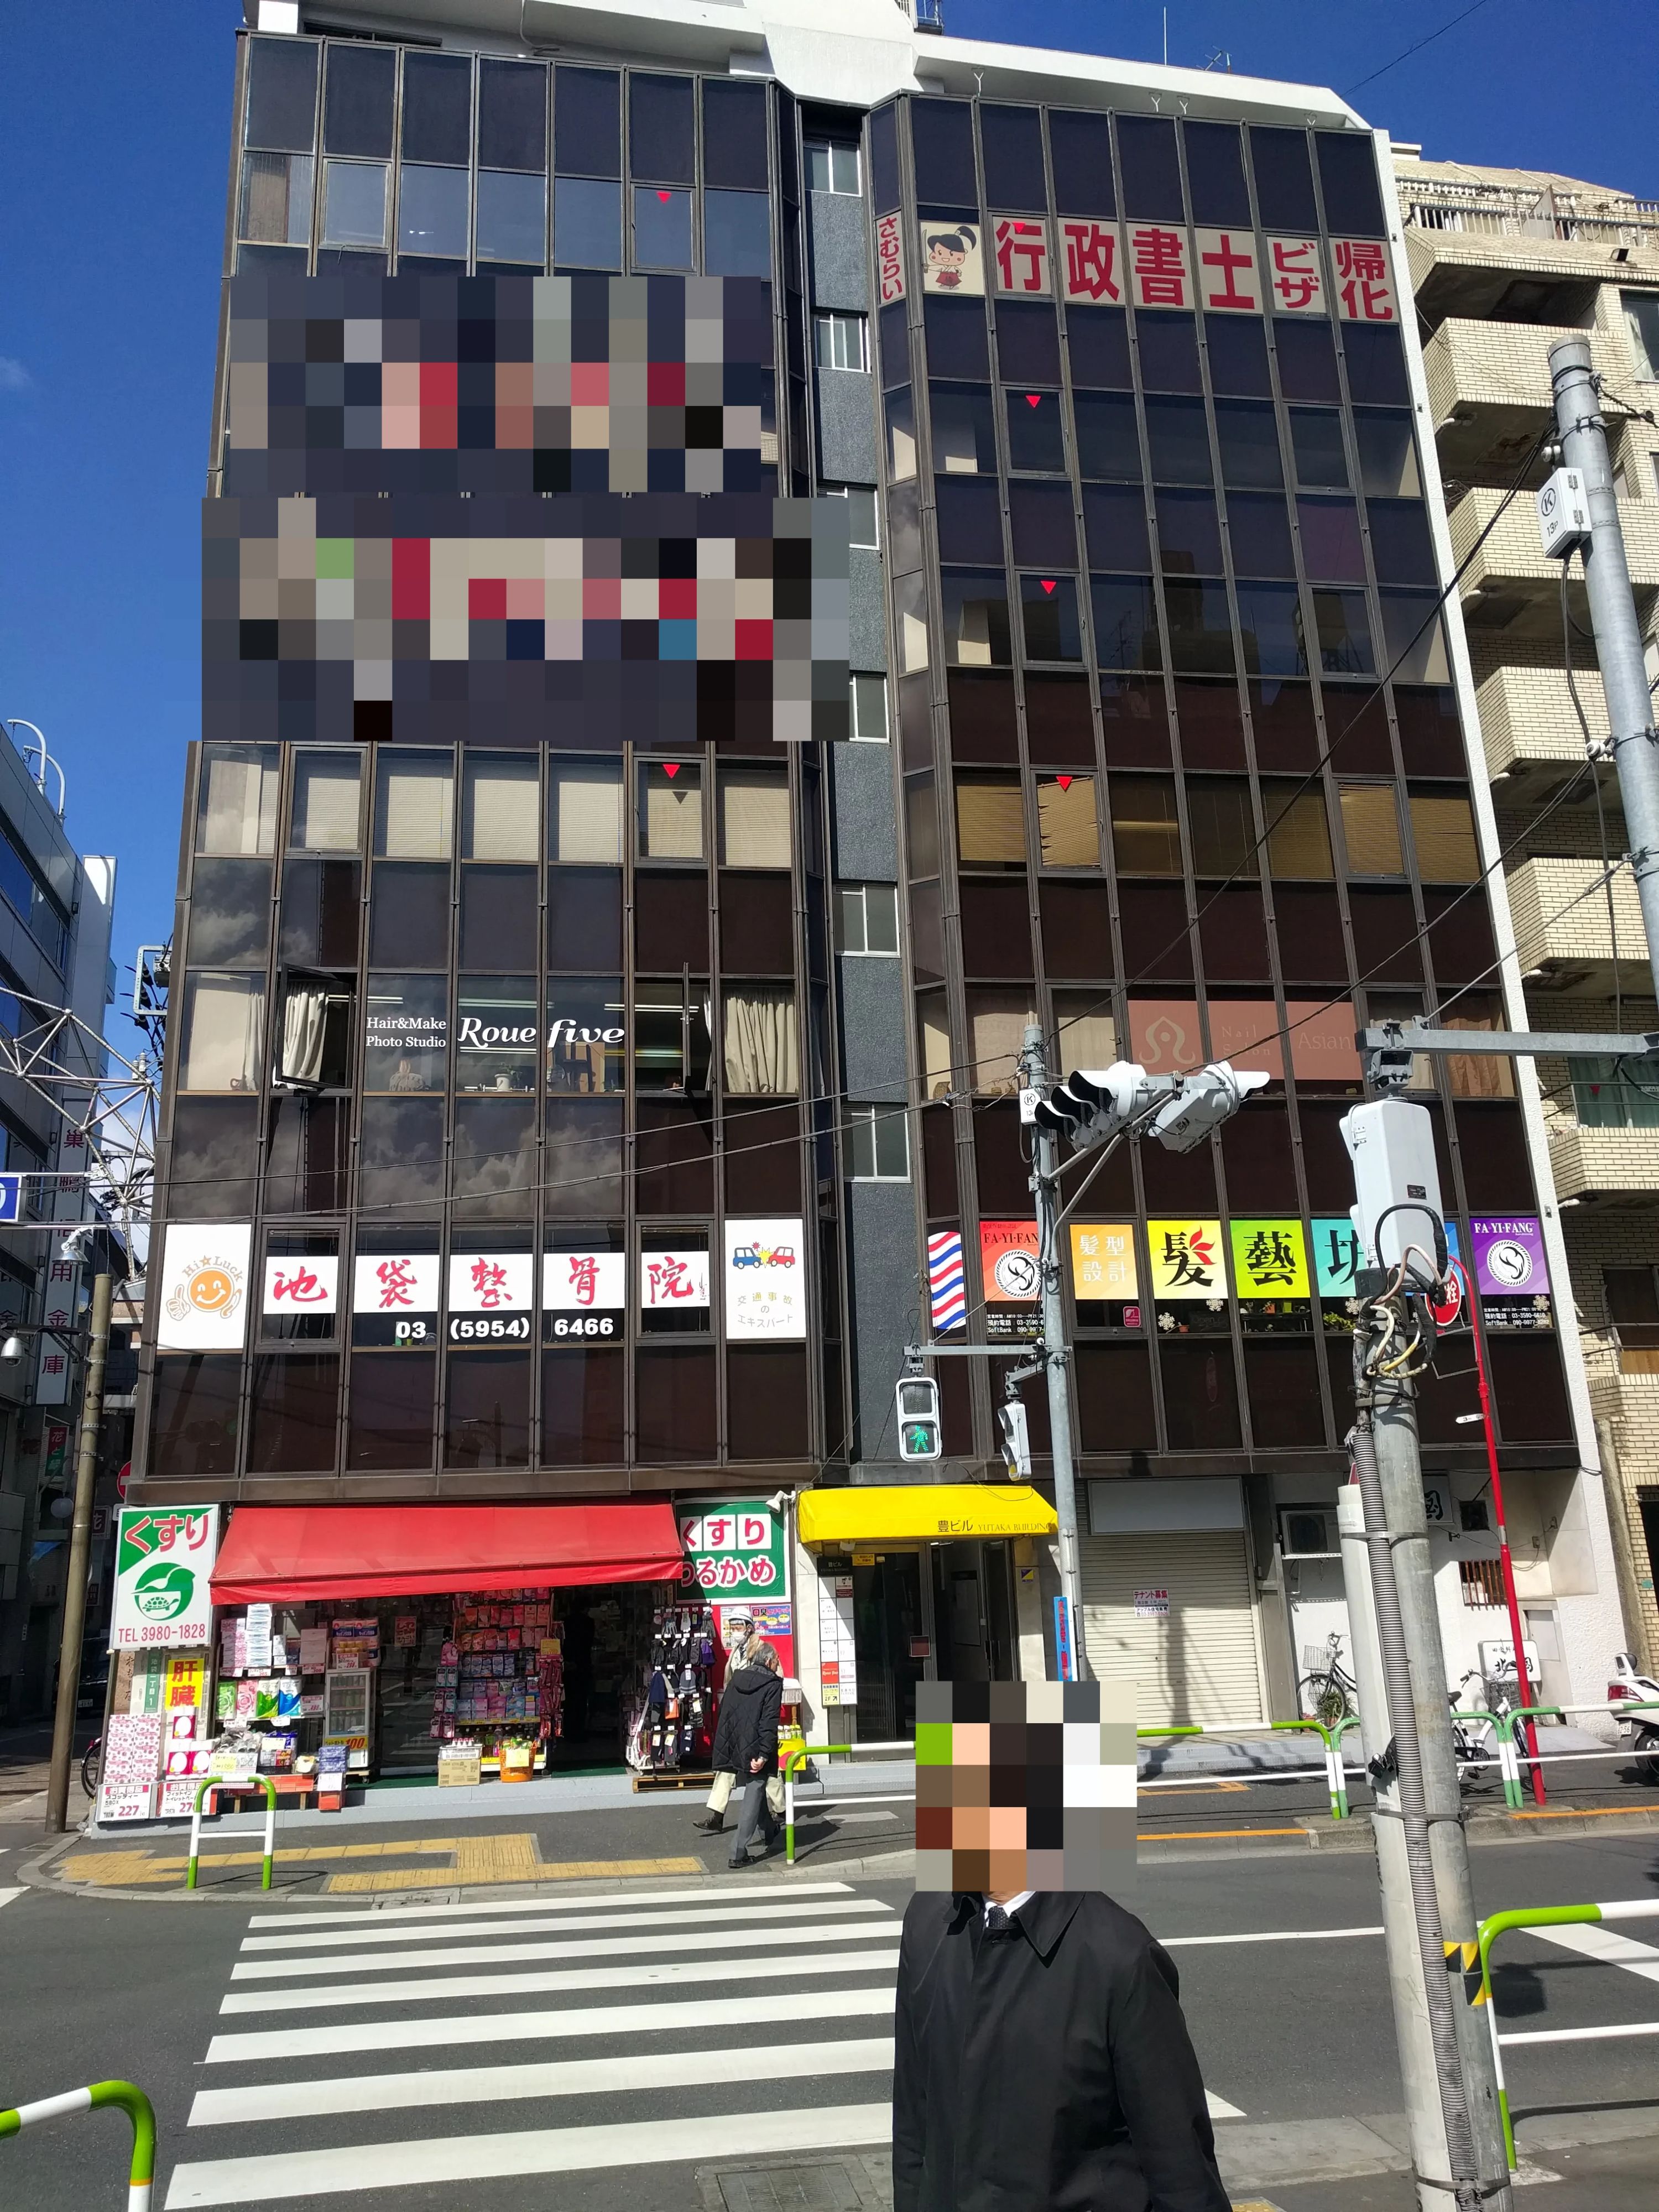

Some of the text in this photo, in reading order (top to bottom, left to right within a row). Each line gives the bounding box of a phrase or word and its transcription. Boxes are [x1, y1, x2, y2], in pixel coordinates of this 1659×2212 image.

[879, 217, 902, 300] さむらい
[998, 220, 1393, 319] 行政書士 ビザ 帰化
[366, 1036, 446, 1047] Photo Studio
[367, 1017, 625, 1049] Hair&Make Roue five
[1222, 1025, 1352, 1050] Nail Asian
[273, 1256, 693, 1308] 池袋整骨院
[1082, 1261, 1128, 1282] 設計
[738, 1292, 792, 1306] 交通事故
[396, 1317, 614, 1340] 03 (5954) 6466
[124, 1515, 209, 1554] くすり
[683, 1518, 765, 1547] くすり
[938, 1520, 973, 1532] 豊ビル
[1014, 1523, 1052, 1531] BUILDING
[1134, 1590, 1167, 1599] テナント募集
[118, 1623, 205, 1643] TEL 3980-1828
[170, 1661, 199, 1707] 肝臓
[118, 1805, 139, 1817] 227
